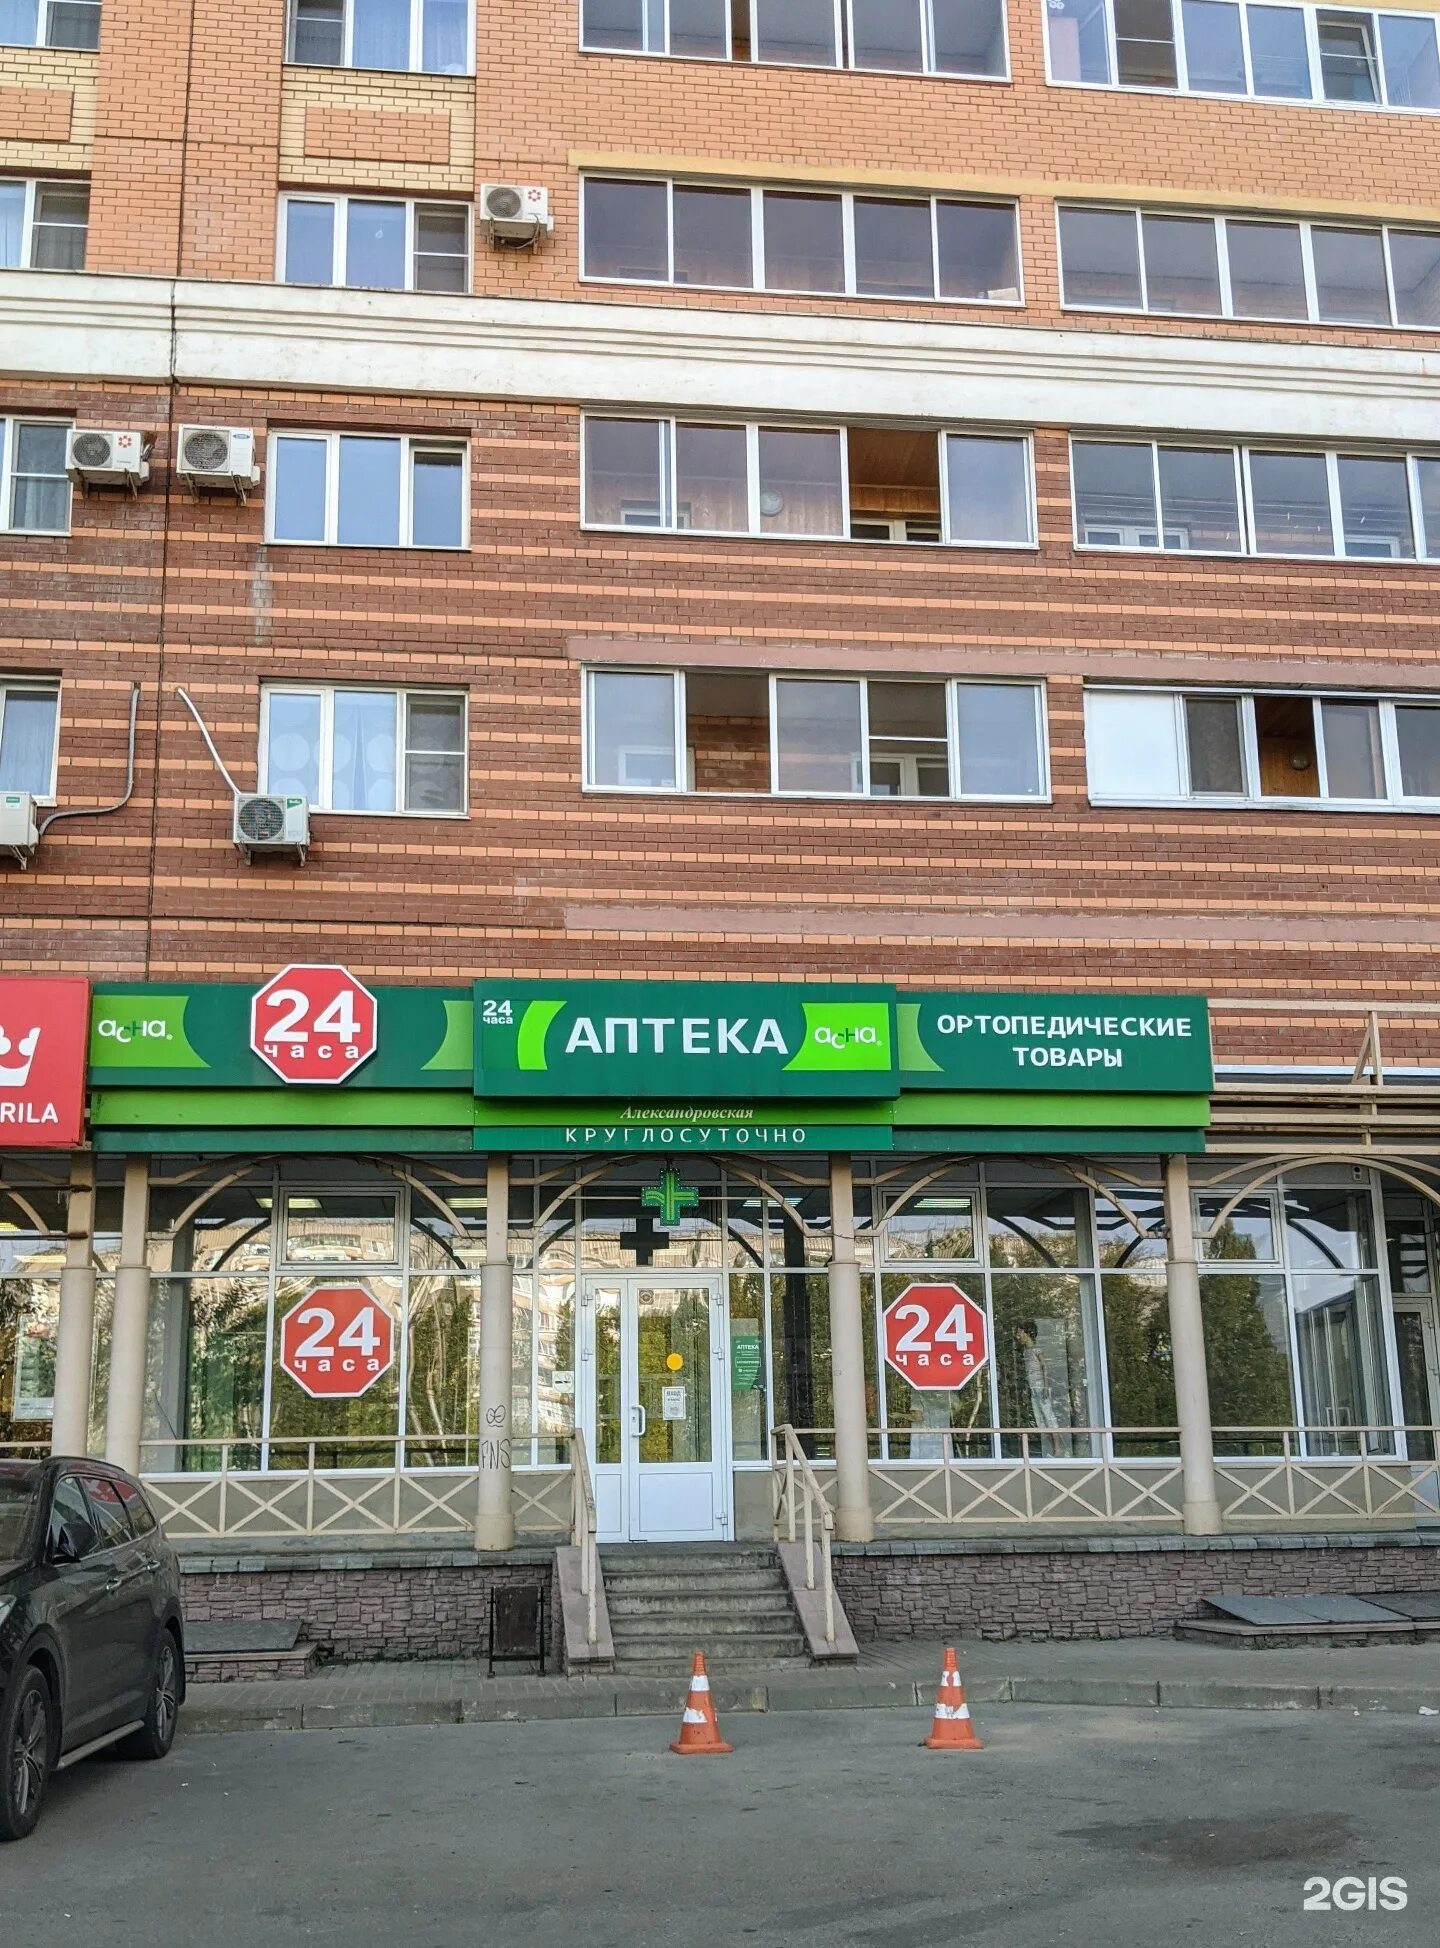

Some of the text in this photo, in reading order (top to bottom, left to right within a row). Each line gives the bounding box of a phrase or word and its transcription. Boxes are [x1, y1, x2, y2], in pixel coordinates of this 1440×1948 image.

[263, 988, 361, 1044] 24
[483, 1000, 513, 1017] 24
[482, 1016, 514, 1025] часа
[936, 1014, 1193, 1039] ОРТОПЕДИЧЕСКИЕ
[565, 1017, 789, 1055] АПТЕКА
[263, 1044, 360, 1059] часа
[1012, 1047, 1123, 1068] ТОВАРЫ
[0, 1102, 59, 1123] RILA
[619, 1105, 754, 1122] Александровская
[565, 1127, 806, 1144] КРУГЛОСУТОЧНО
[294, 1306, 381, 1357] 24
[894, 1303, 974, 1351] 24
[293, 1358, 380, 1373] часа
[895, 1353, 975, 1366] часа
